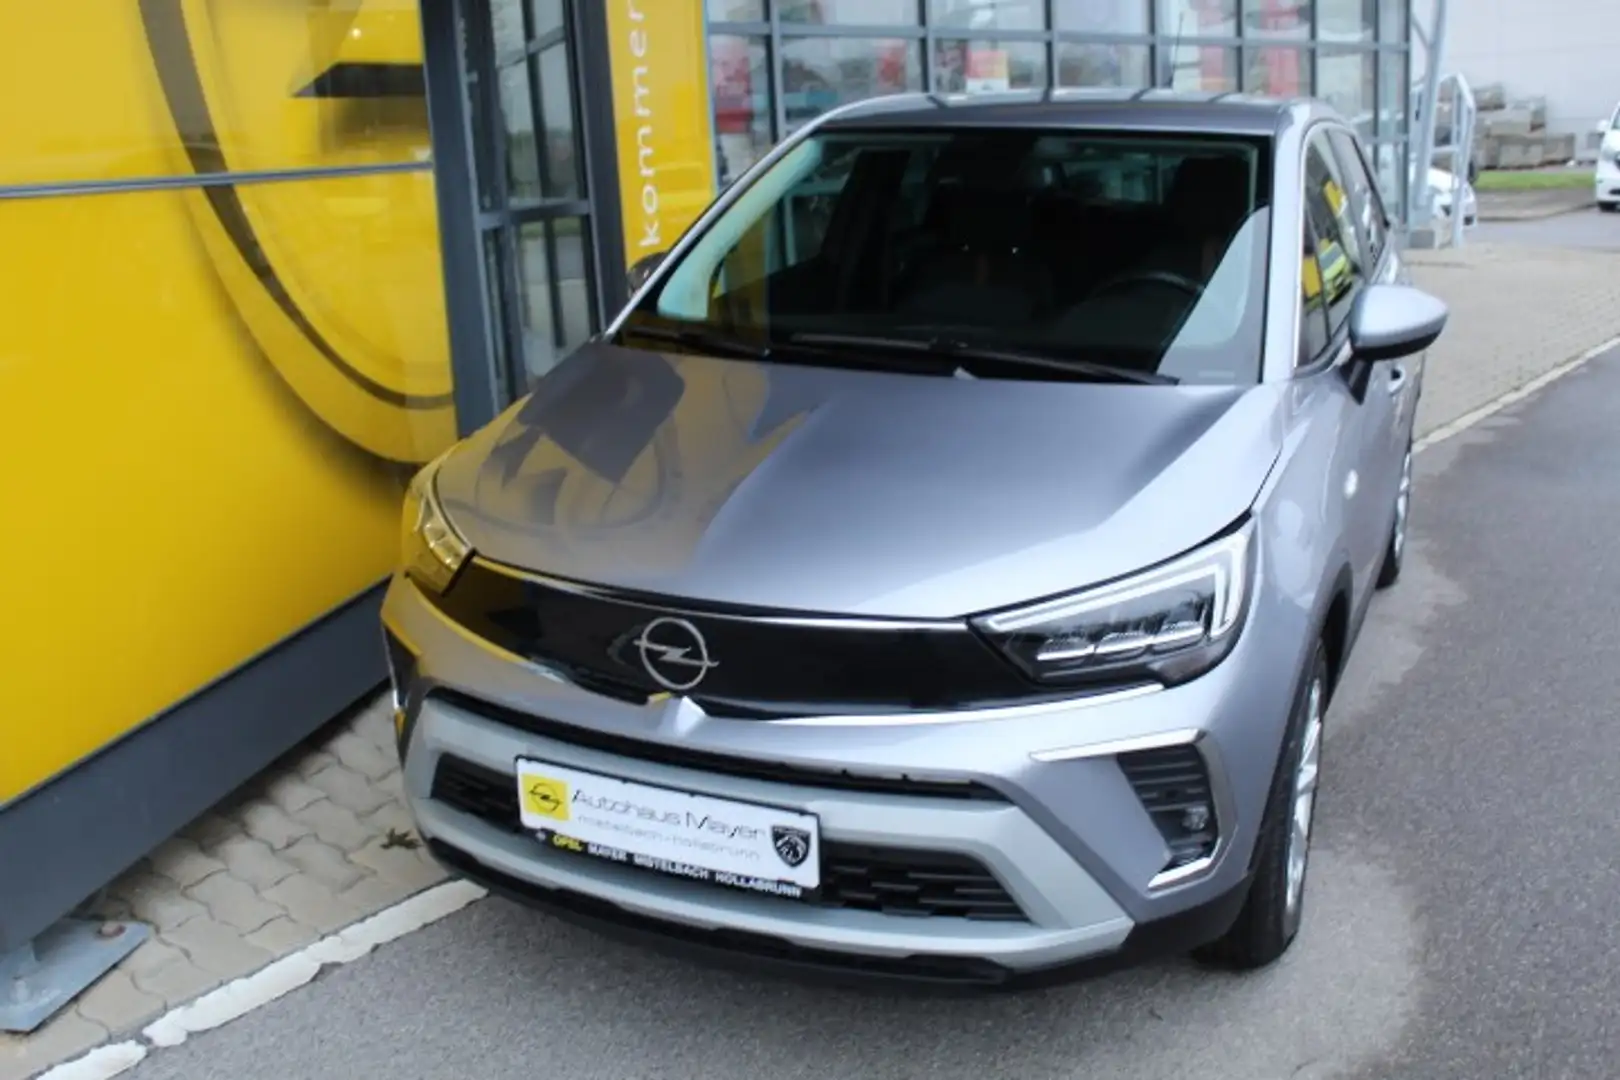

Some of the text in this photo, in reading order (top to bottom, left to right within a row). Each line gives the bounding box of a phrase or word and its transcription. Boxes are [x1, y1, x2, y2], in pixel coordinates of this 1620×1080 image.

[572, 790, 765, 839] Autohaus Mayer
[553, 833, 584, 850] OPEL
[587, 842, 627, 861] MAYER
